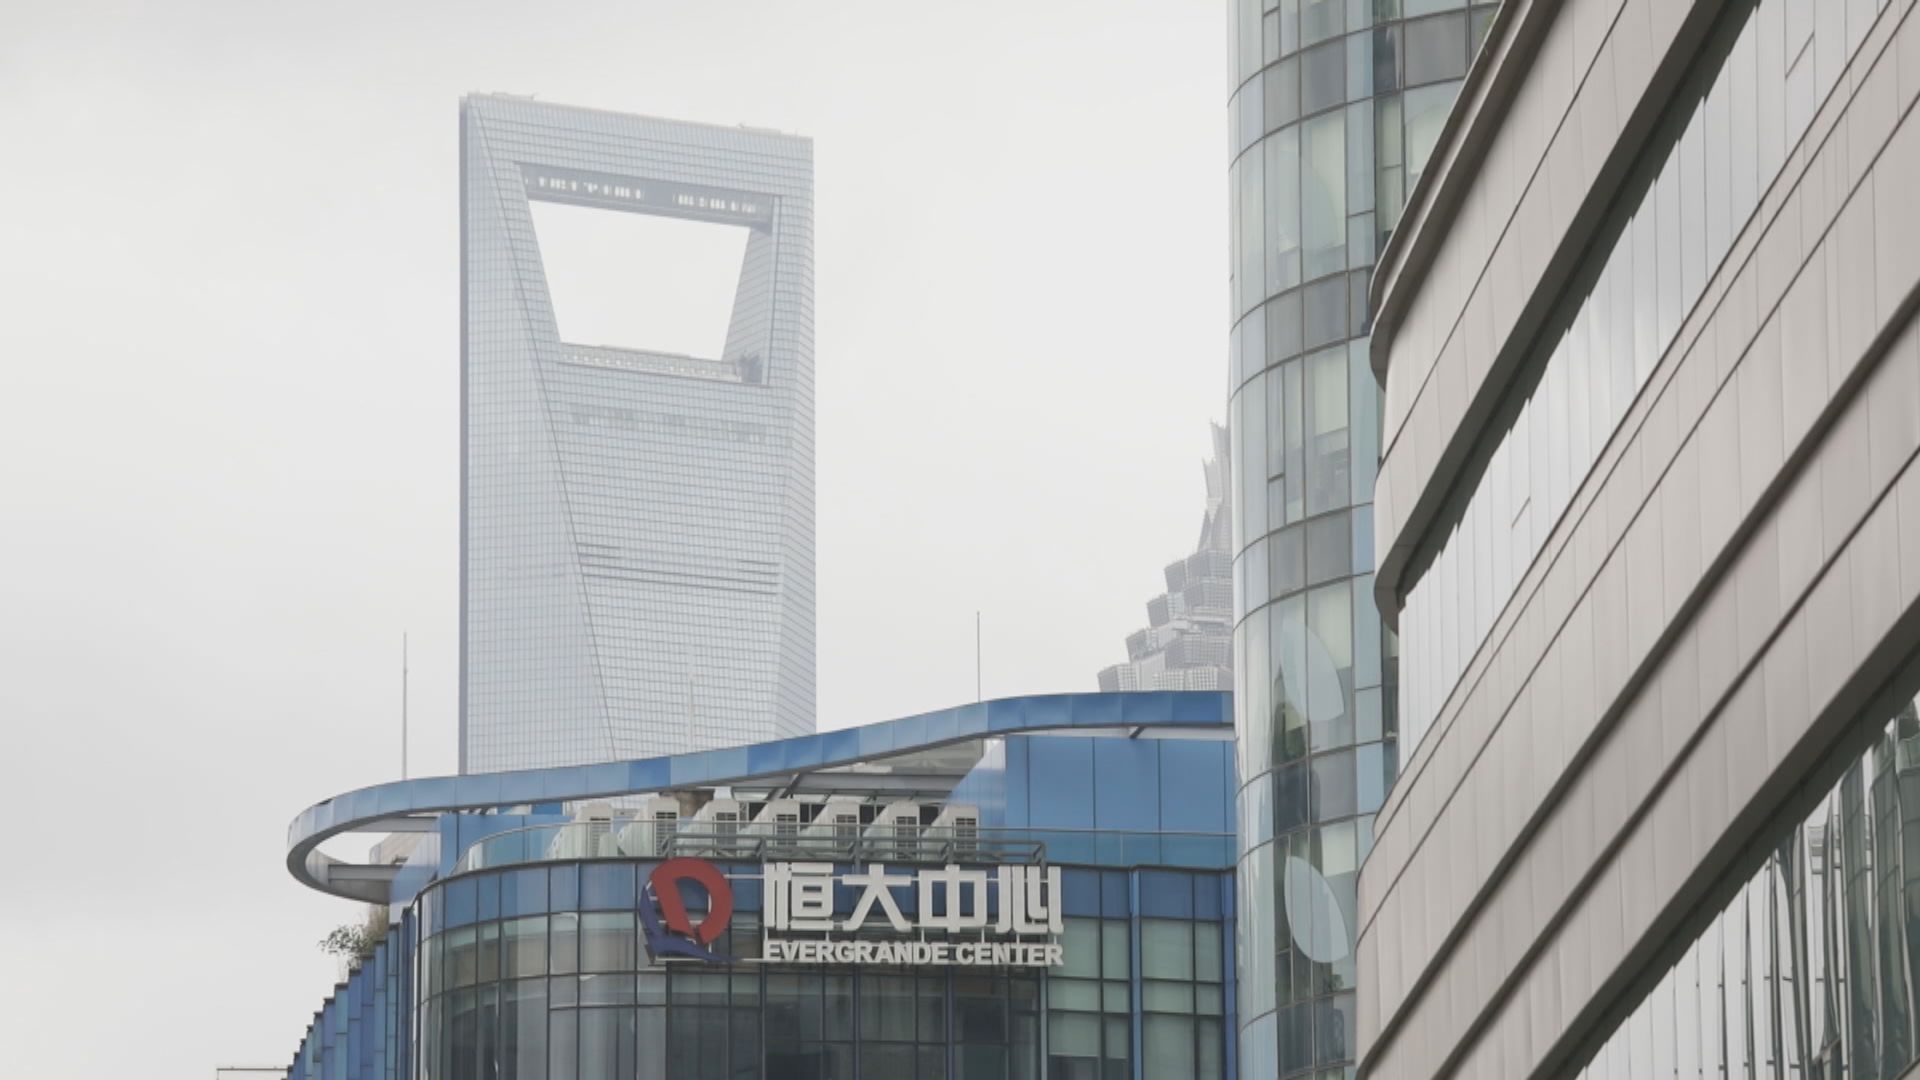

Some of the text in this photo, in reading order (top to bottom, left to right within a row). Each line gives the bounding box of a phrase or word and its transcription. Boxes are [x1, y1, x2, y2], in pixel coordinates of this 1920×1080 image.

[763, 862, 1064, 934] 恒大中心
[763, 940, 1063, 967] EVERGRANDE CENTER
